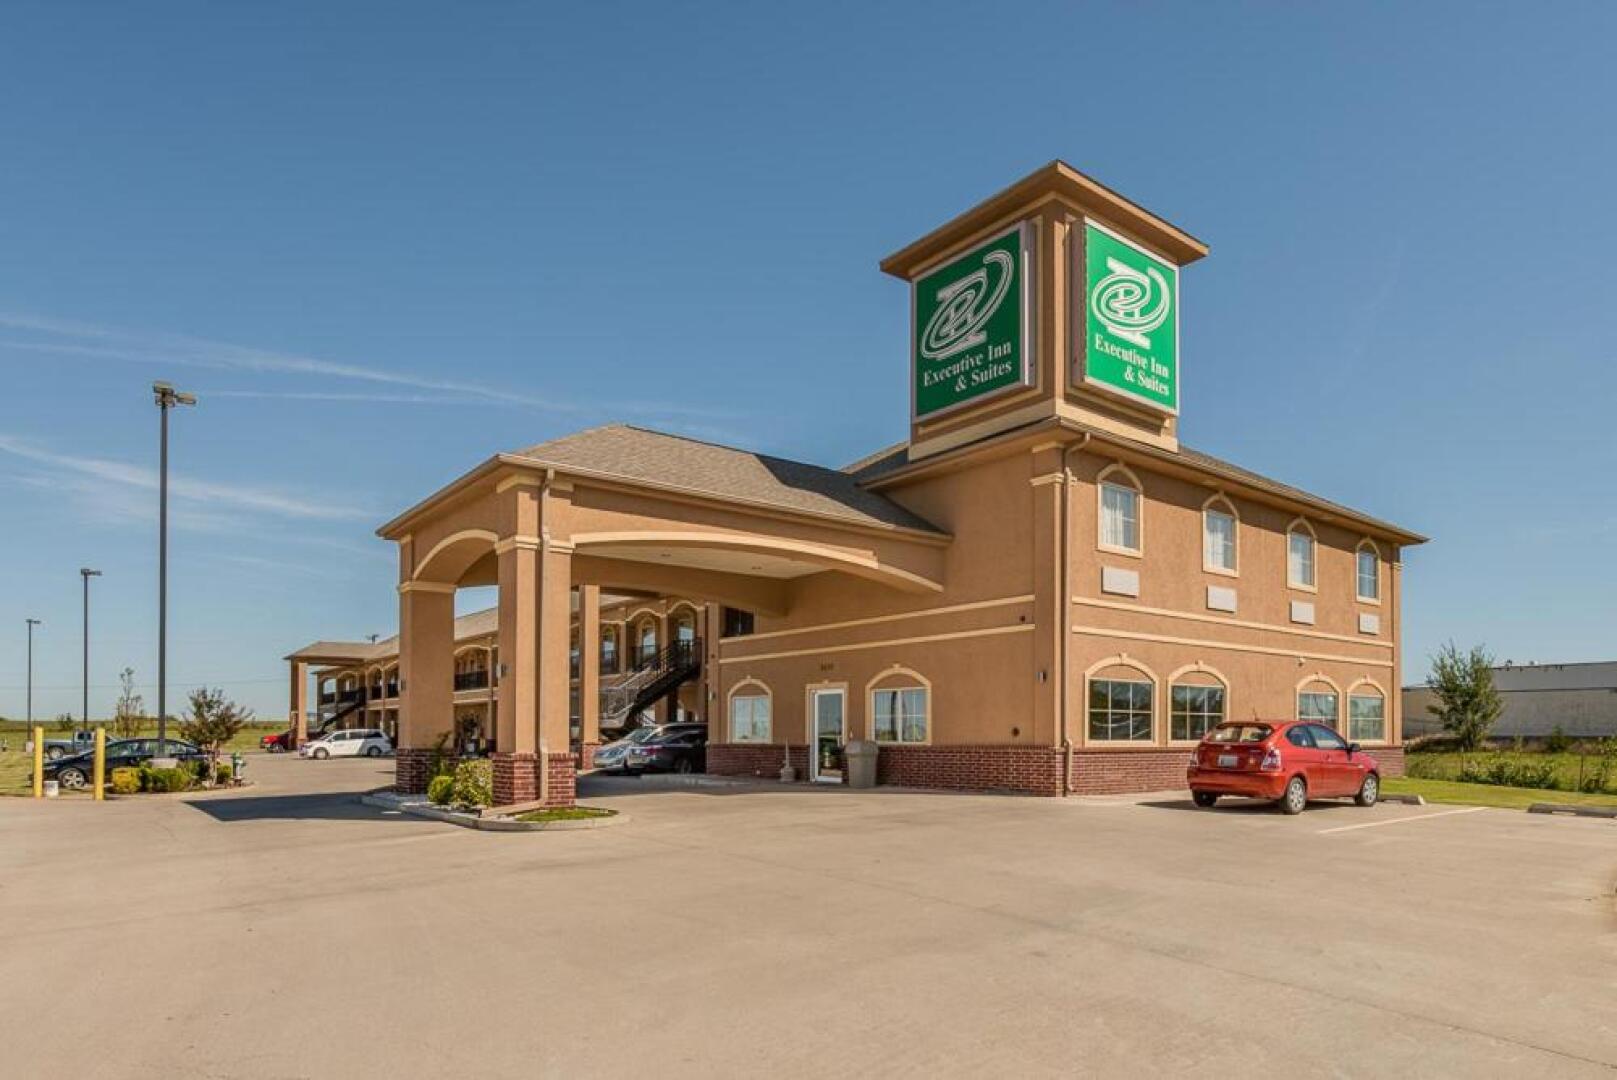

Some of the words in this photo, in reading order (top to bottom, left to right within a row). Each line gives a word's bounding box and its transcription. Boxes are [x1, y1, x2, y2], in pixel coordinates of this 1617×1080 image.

[924, 354, 983, 387] Executive
[988, 342, 1011, 361] Inn
[1095, 332, 1148, 369] Executive
[1151, 357, 1169, 378] Inn
[955, 374, 967, 392] &
[971, 361, 1012, 386] Suites
[1124, 365, 1135, 382] &
[1138, 369, 1169, 396] Suites
